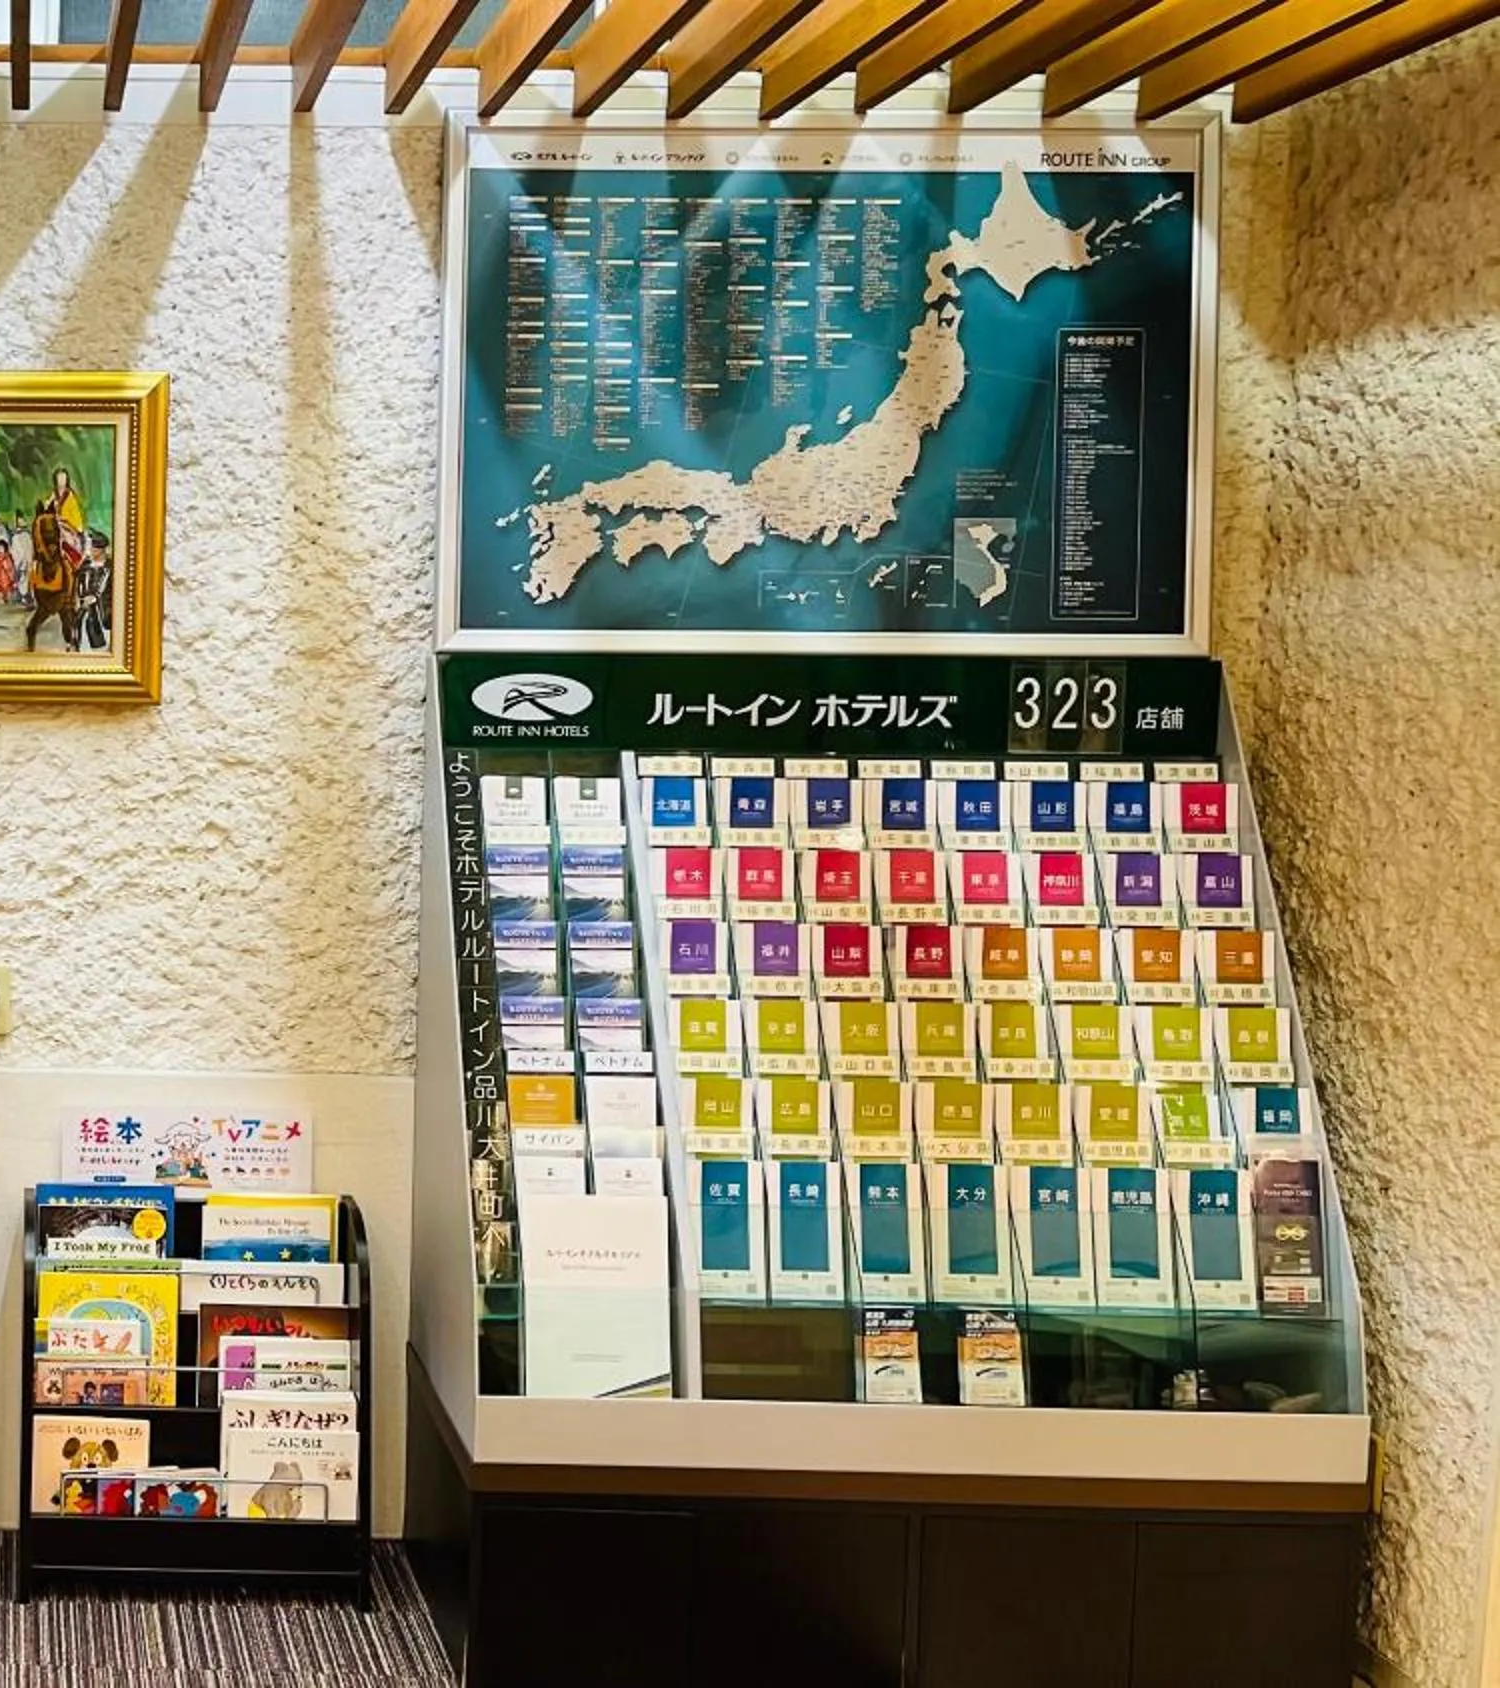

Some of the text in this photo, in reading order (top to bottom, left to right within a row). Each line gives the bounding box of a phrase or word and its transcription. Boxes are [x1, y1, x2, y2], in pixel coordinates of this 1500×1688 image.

[1041, 153, 1093, 166] ROUTE
[1131, 157, 1171, 167] GROUP
[647, 677, 1185, 730] ルートイン ホテルズ 323 店舗
[472, 725, 590, 738] ROUTE INN HOTELS
[815, 799, 844, 812] 岩手
[963, 801, 992, 814] 秋田
[1037, 802, 1067, 815] 山形
[1113, 803, 1143, 816] 福島
[1188, 803, 1219, 817] 茨城
[823, 872, 853, 885] 埼玉
[1043, 875, 1080, 887] 神奈川
[1203, 875, 1235, 889] 富山
[679, 944, 709, 956] 石川
[761, 944, 789, 957] 福井
[831, 947, 862, 960] 山梨
[914, 947, 943, 960] 長野
[1141, 949, 1173, 964] 愛知
[1223, 951, 1255, 965] 三重
[849, 1023, 880, 1037] 大阪
[1075, 1027, 1115, 1041] 和歌山
[516, 1056, 565, 1067] ベトナム
[595, 1055, 643, 1067] ベトナム
[704, 1099, 735, 1113] 岡山
[779, 1103, 811, 1116] 広島
[861, 1104, 892, 1118] 山口
[1021, 1106, 1051, 1119] 香川
[80, 1116, 301, 1145] 絵本 TVアニメ
[525, 1133, 575, 1145] サイパン
[709, 1184, 740, 1197] 佐賀
[788, 1184, 819, 1198] 長崎
[867, 1185, 899, 1199] 熊本
[956, 1186, 987, 1201] 大分
[1037, 1189, 1068, 1203] 宮崎
[1111, 1190, 1153, 1205] 鹿児島
[1197, 1193, 1229, 1207] 沖縄
[55, 1242, 150, 1253] I Took My Frog
[267, 1437, 323, 1449] こんにちは
